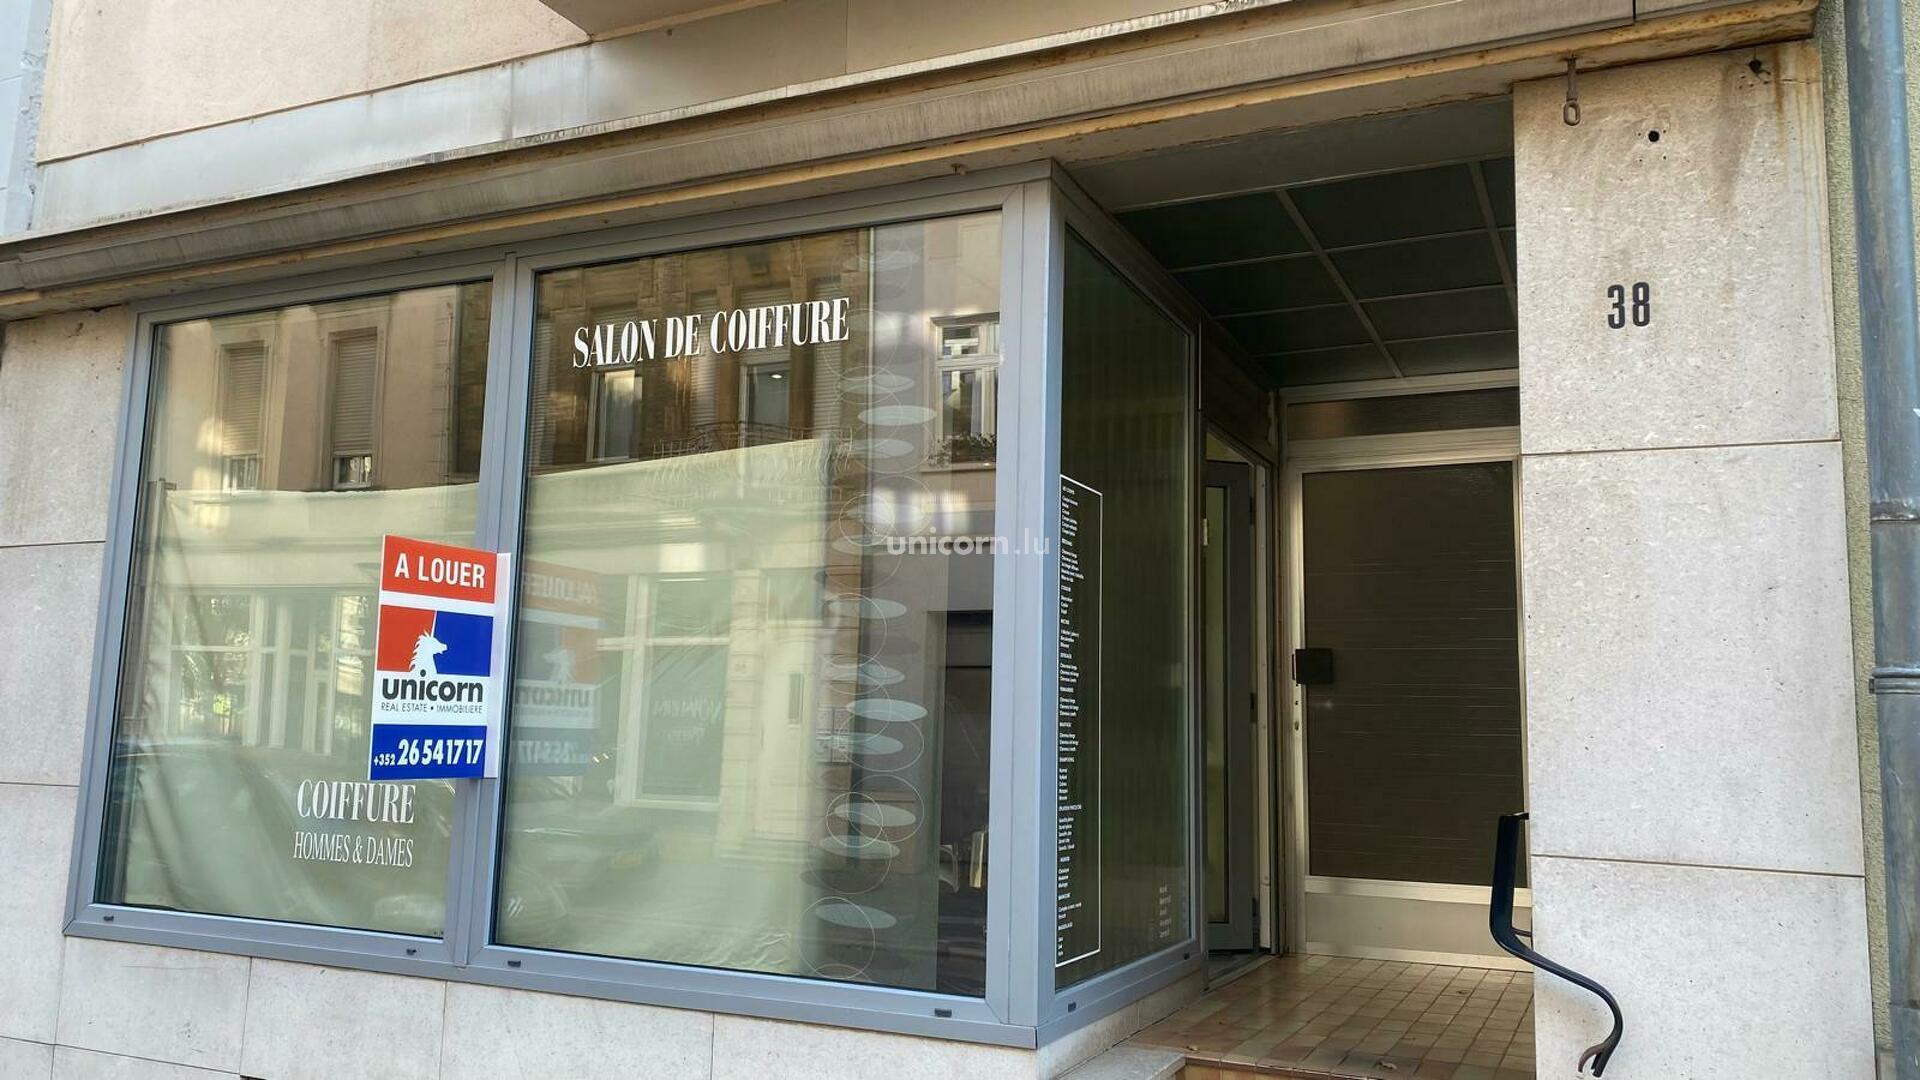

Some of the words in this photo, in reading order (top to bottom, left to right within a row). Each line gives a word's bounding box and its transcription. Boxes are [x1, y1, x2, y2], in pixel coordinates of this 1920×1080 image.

[1607, 281, 1650, 329] 38
[573, 318, 657, 368] SALON
[664, 314, 702, 359] DE
[710, 297, 850, 354] COIFFURE
[394, 552, 410, 579] A
[418, 555, 485, 589] LOUER
[382, 669, 484, 702] unicorn
[381, 702, 399, 712] REAL
[401, 703, 428, 713] ESTATE
[373, 753, 396, 766] +352
[297, 779, 416, 824] COIFFURE
[293, 831, 350, 863] HOMMES
[352, 835, 363, 864] &
[366, 836, 413, 868] DAMES
